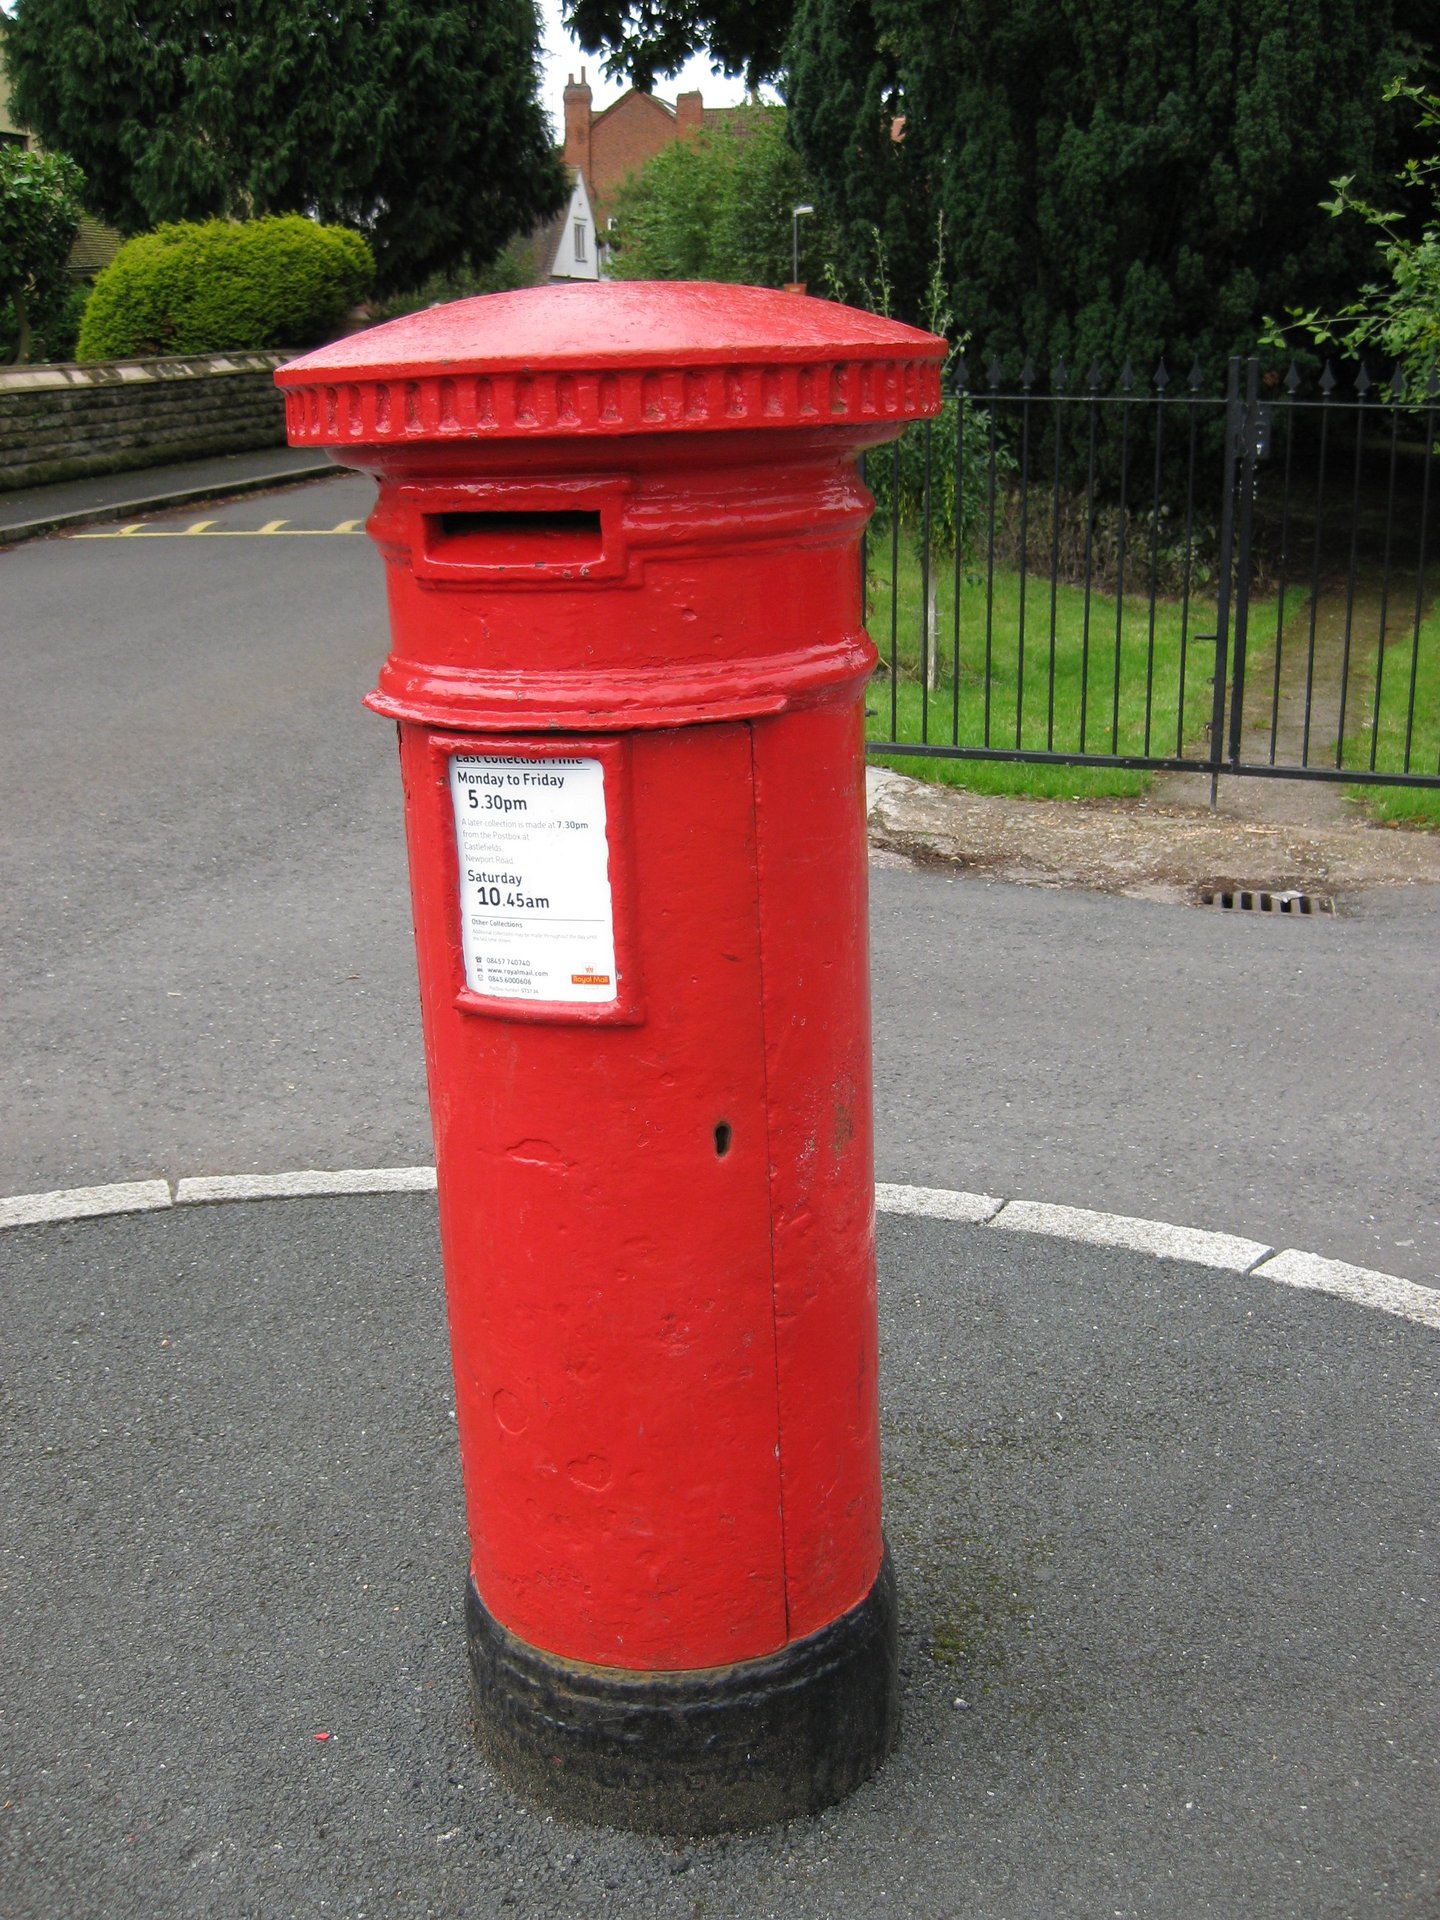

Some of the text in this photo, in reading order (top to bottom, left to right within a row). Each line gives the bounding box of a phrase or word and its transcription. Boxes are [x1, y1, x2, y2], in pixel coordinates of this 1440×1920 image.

[457, 771, 565, 789] Monday to Friday
[468, 789, 528, 813] 5.30pm
[467, 818, 483, 828] later
[484, 819, 517, 829] collection
[525, 820, 547, 829] made
[547, 821, 556, 829] at
[556, 820, 589, 831] 7.30pm
[462, 830, 530, 841] from the Postbox at
[465, 853, 494, 865] Newport
[467, 869, 522, 887] Saturday
[477, 886, 550, 909] 10.45am
[471, 918, 523, 929] Other Collections
[487, 967, 549, 978] www.royalmail.com
[573, 975, 609, 984] Royal Mail
